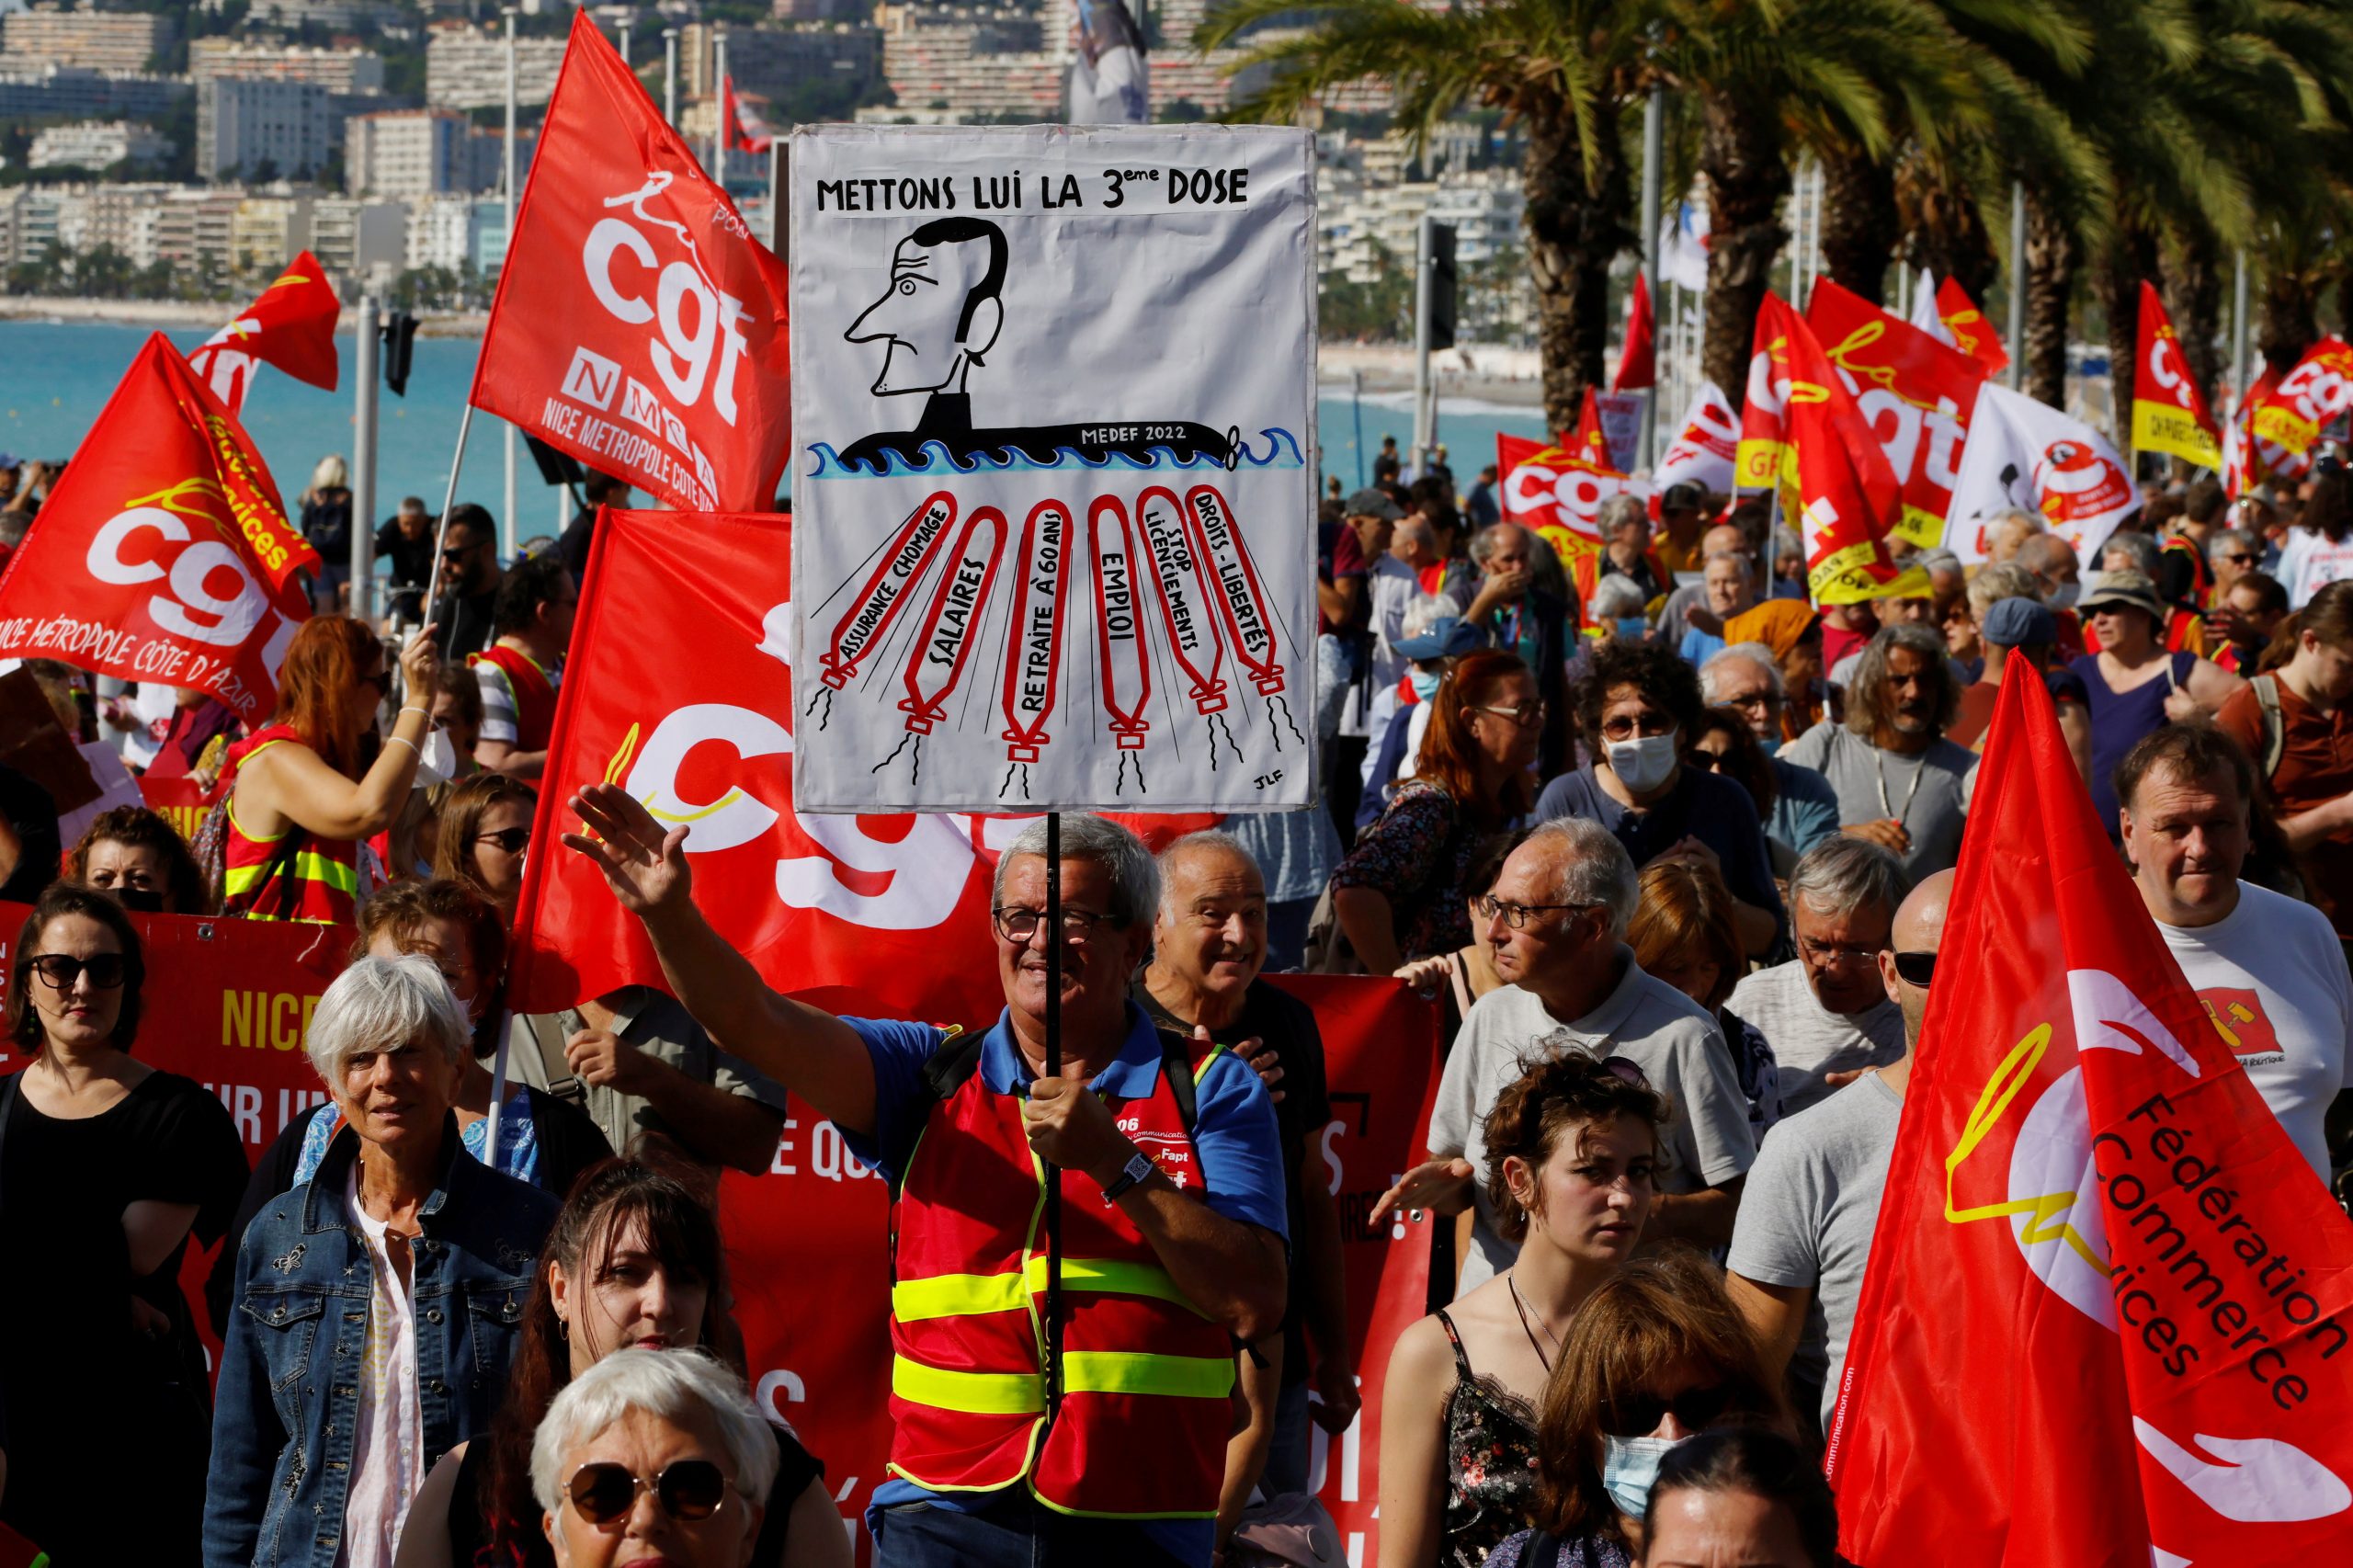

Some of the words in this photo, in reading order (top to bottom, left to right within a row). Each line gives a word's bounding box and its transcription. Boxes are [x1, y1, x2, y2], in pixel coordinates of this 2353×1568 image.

[818, 176, 956, 211] METTONS
[1041, 175, 1083, 209] LA
[1168, 169, 1249, 204] DOSE
[583, 217, 756, 427] cgt
[540, 397, 582, 439] NICE
[577, 415, 671, 483] METROPOLE
[672, 462, 699, 506] COTE
[1081, 426, 1139, 445] MEDEF
[1145, 426, 1187, 440] 2022
[1042, 512, 1062, 546] ANS
[1166, 528, 1192, 573] STOP
[1038, 546, 1059, 574] 60
[840, 581, 899, 660] ASSURANCE
[892, 507, 947, 577] CHOMAGE
[1029, 577, 1055, 597] À
[1101, 552, 1135, 641] EMPLOI
[26, 613, 136, 666] MÉTROPOLE
[134, 639, 190, 677] CÔTE
[185, 653, 257, 718] D'AZUR
[1254, 769, 1283, 790] JLF
[1161, 1148, 1188, 1163] Fapt
[2126, 1093, 2348, 1360] Fédération
[2093, 1132, 2309, 1410] Commerce
